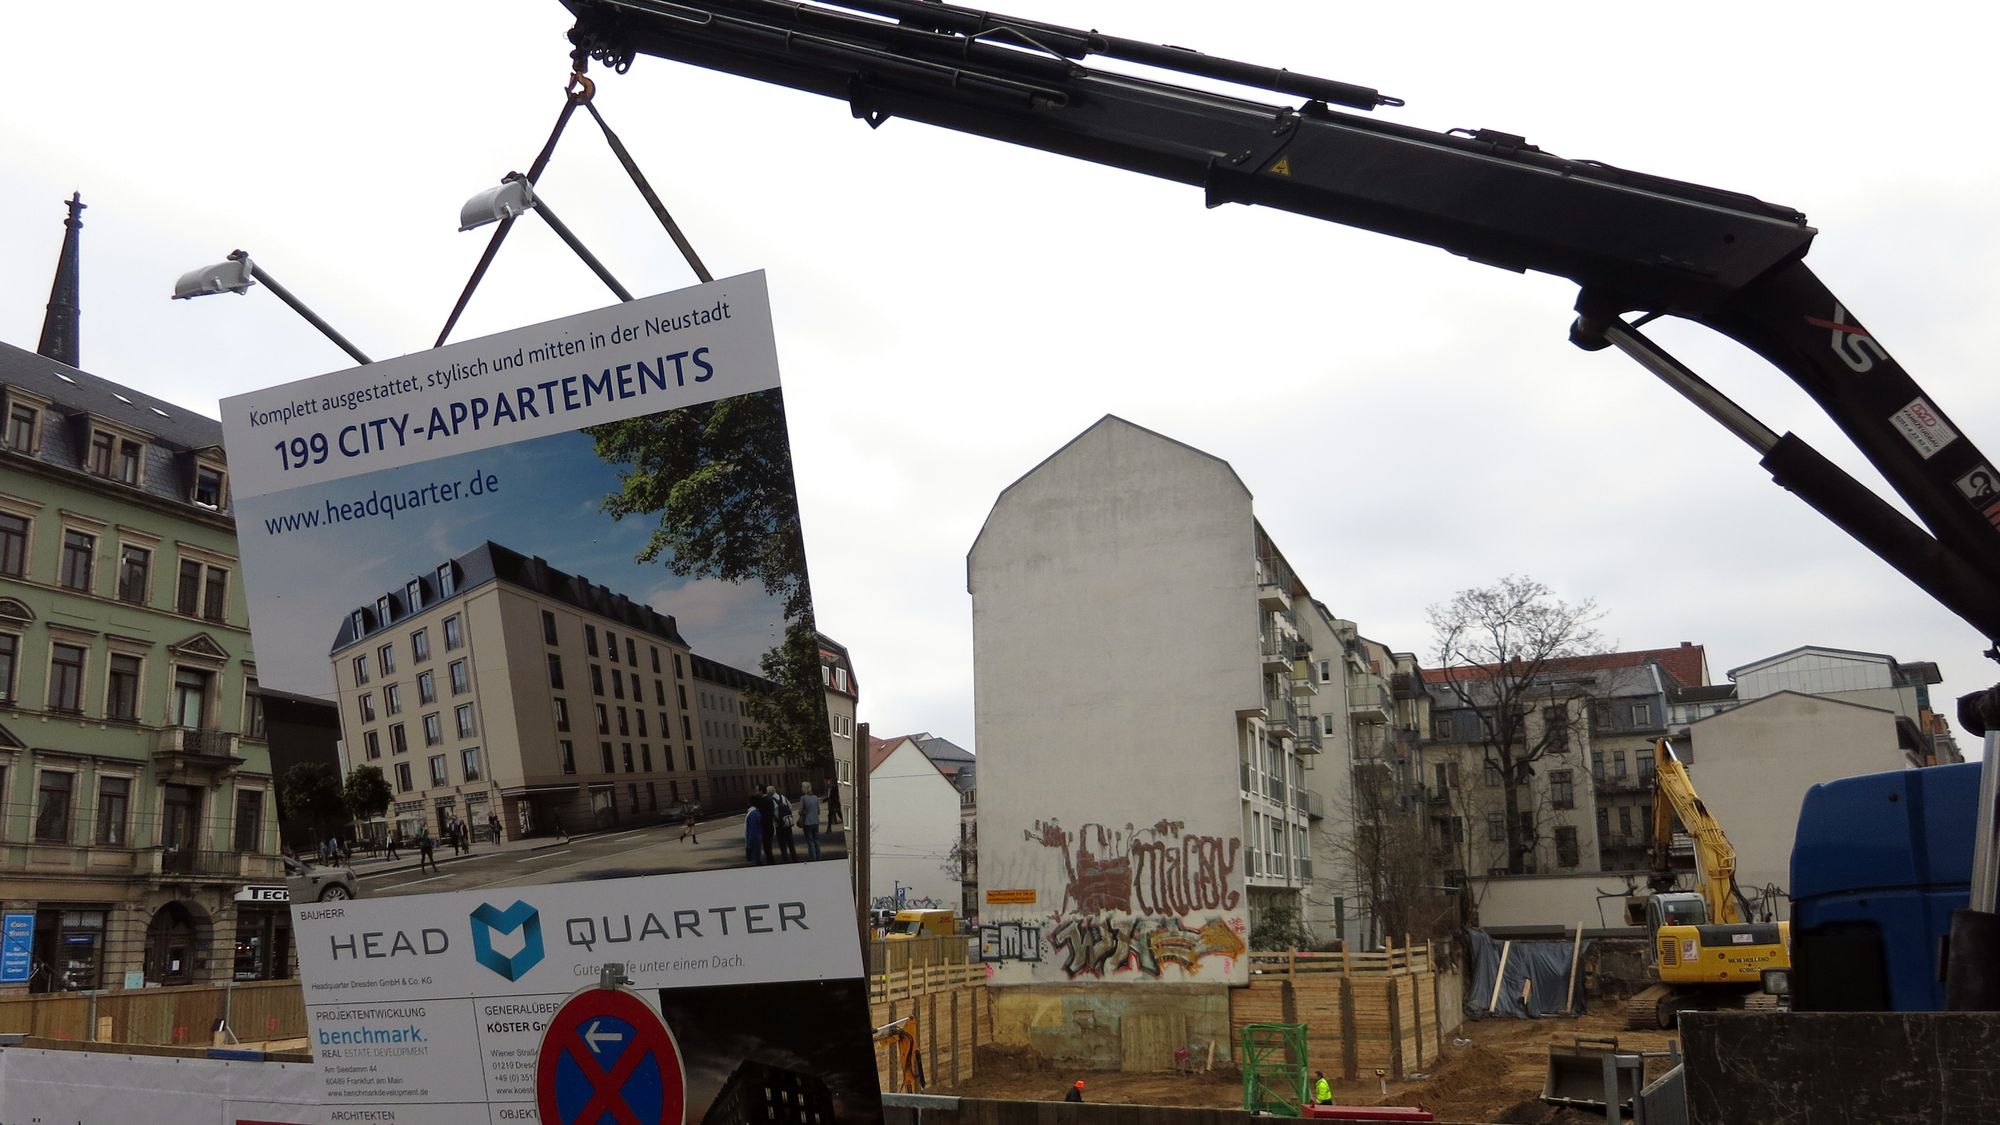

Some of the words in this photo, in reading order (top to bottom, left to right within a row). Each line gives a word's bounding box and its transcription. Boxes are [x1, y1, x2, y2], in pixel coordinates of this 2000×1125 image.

[250, 399, 318, 427] Komplett
[322, 375, 424, 411] ausgestattet,
[427, 358, 489, 389] stylisch
[493, 348, 524, 372] und
[528, 339, 585, 365] mitten
[590, 331, 606, 349] in
[611, 325, 640, 346] der
[645, 301, 732, 337] Neustadt
[274, 432, 330, 471] 199
[338, 346, 715, 458] CITY-APPARTEMENTS
[264, 469, 499, 536] www.headquarter.de
[300, 908, 346, 921] BAUHERR
[330, 928, 450, 961] HEAD
[566, 901, 810, 953] QUARTER
[573, 962, 601, 976] Gute
[639, 958, 670, 973] unter
[673, 956, 709, 971] einem
[712, 954, 745, 968] Dach.
[311, 981, 350, 991] Headquarter
[351, 979, 378, 989] Dresden
[379, 978, 400, 987] GmbH
[402, 977, 407, 985] &
[421, 976, 433, 985] KG
[316, 1007, 427, 1021] PROJEKTENTWICKLUNG
[487, 1021, 530, 1033] KÖSTER
[319, 1024, 429, 1046] benchmark.
[322, 1049, 342, 1058] REAL
[344, 1048, 371, 1058] ESTATE
[374, 1046, 429, 1057] DEVELOPMENT
[490, 1049, 515, 1057] Wiener
[324, 1066, 335, 1074] Am
[369, 1065, 378, 1073] 44
[492, 1062, 514, 1070] 01219
[388, 1076, 404, 1085] Main
[509, 1073, 519, 1083] (0)
[331, 1111, 395, 1121] ARCHITEKTEN
